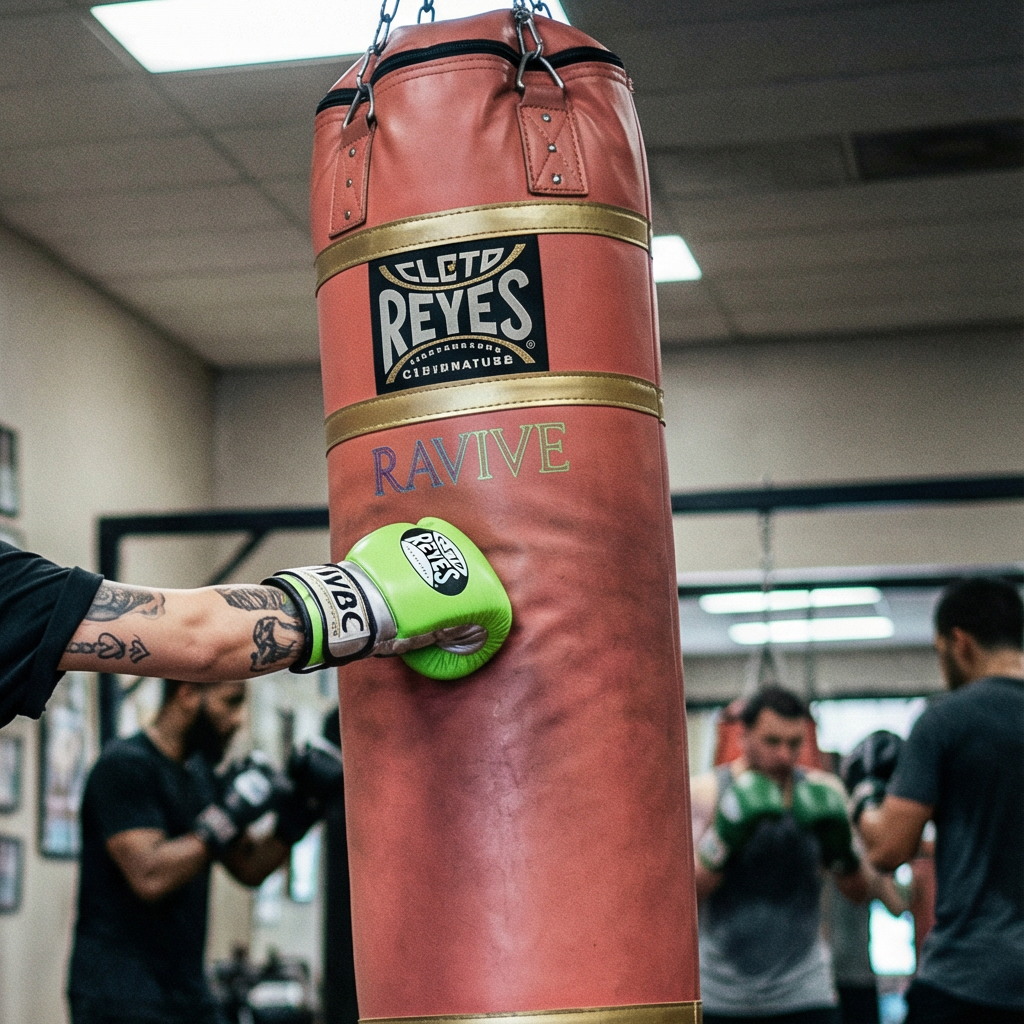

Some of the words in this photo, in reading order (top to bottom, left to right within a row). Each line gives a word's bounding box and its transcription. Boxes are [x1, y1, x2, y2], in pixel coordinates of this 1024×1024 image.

[378, 268, 533, 375] REYES
[372, 421, 570, 496] RAVIVE
[404, 532, 461, 585] REYES
